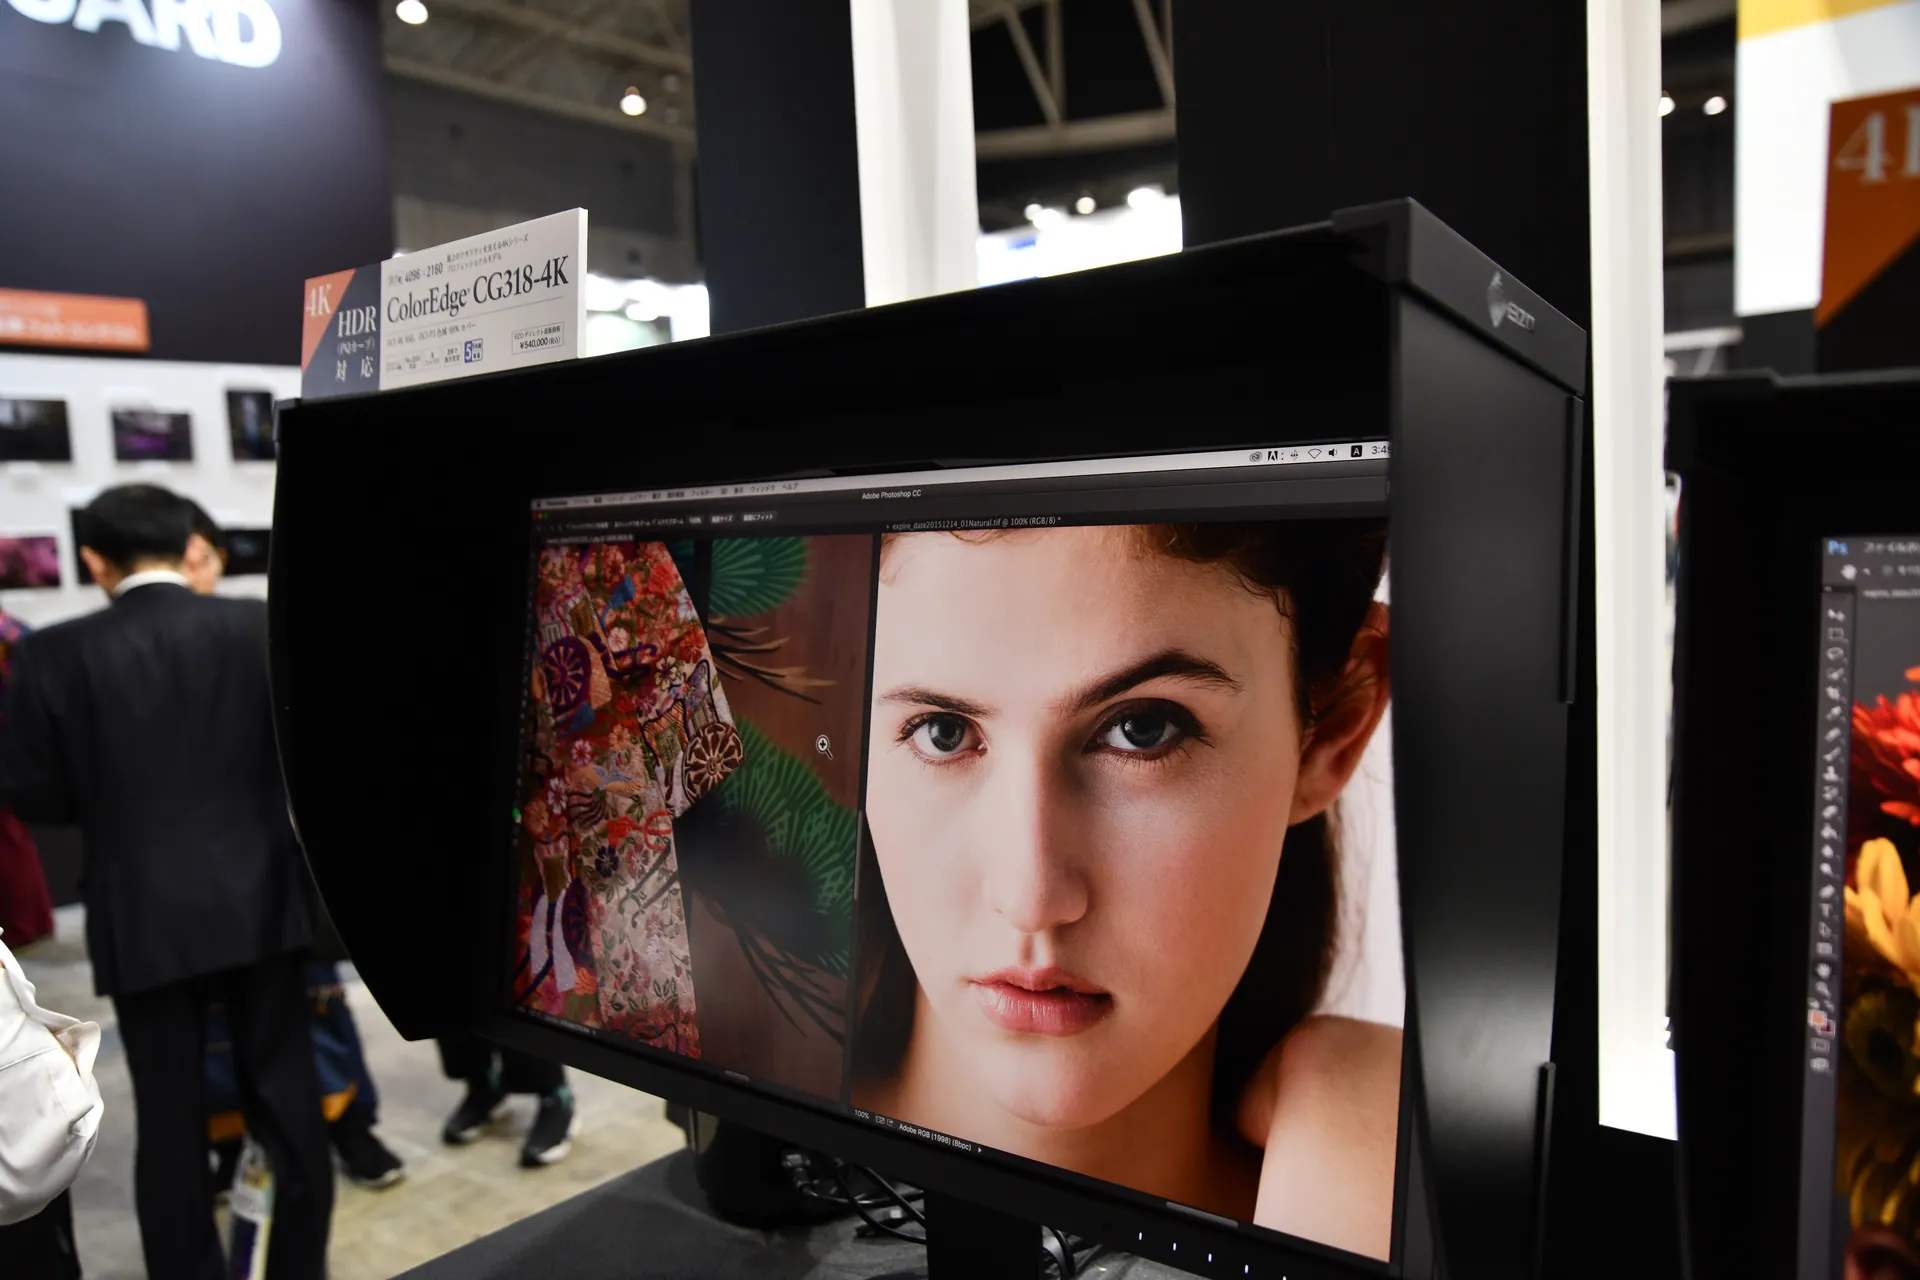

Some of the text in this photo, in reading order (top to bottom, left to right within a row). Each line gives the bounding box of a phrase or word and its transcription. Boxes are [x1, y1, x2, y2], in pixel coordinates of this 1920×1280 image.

[473, 255, 569, 304] CG318-4K
[306, 283, 332, 318] 4K
[338, 305, 377, 338] HDR
[862, 489, 922, 500] Adobe Photoshop CC
[1010, 517, 1028, 526] 100%
[1029, 516, 1056, 526] (RGB/8)
[854, 1109, 870, 1120] 100%
[899, 1124, 917, 1135] Adobe
[917, 1129, 931, 1139] RGB
[952, 1139, 972, 1152] (8bpc)
